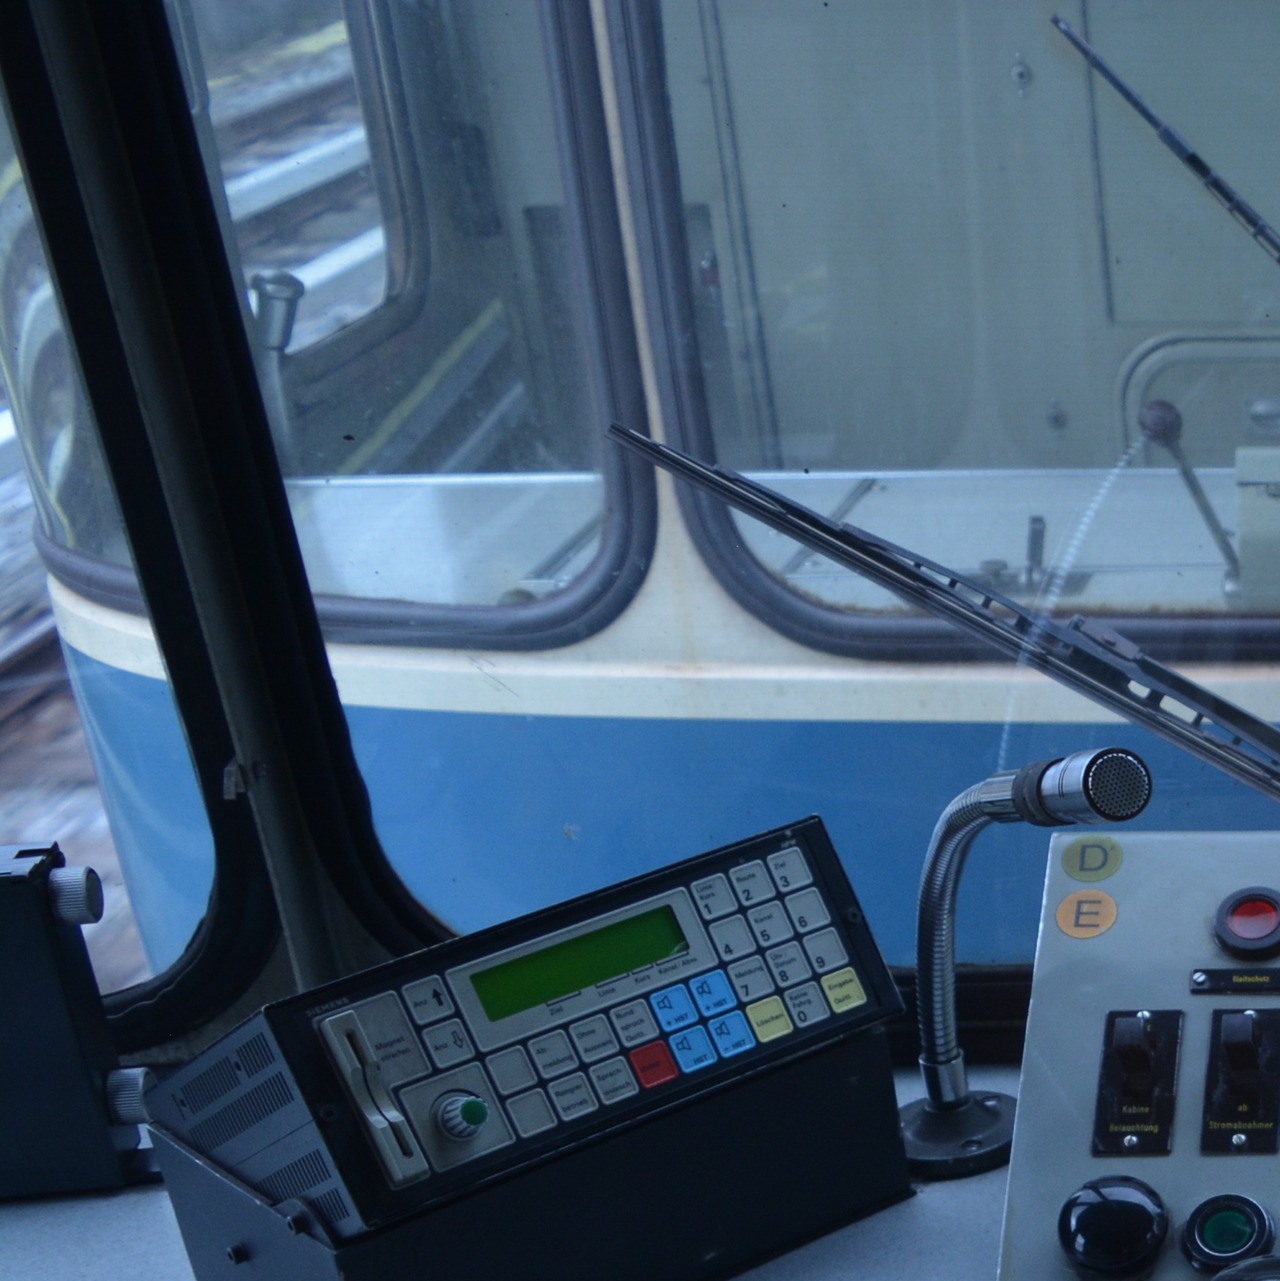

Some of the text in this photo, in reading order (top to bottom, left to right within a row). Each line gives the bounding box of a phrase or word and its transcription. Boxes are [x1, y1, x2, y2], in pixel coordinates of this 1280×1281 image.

[1078, 843, 1109, 872] D
[779, 875, 790, 888] 3
[742, 889, 753, 901] 2
[704, 903, 713, 915] 1
[1073, 899, 1103, 929] E
[797, 915, 808, 928] 6
[760, 929, 771, 942] 5
[723, 943, 734, 955] 4
[816, 956, 826, 969] 9
[778, 970, 789, 982] 8
[741, 984, 750, 997] 7
[797, 1010, 808, 1023] 0
[1208, 1119, 1274, 1131] Stromabnehmer
